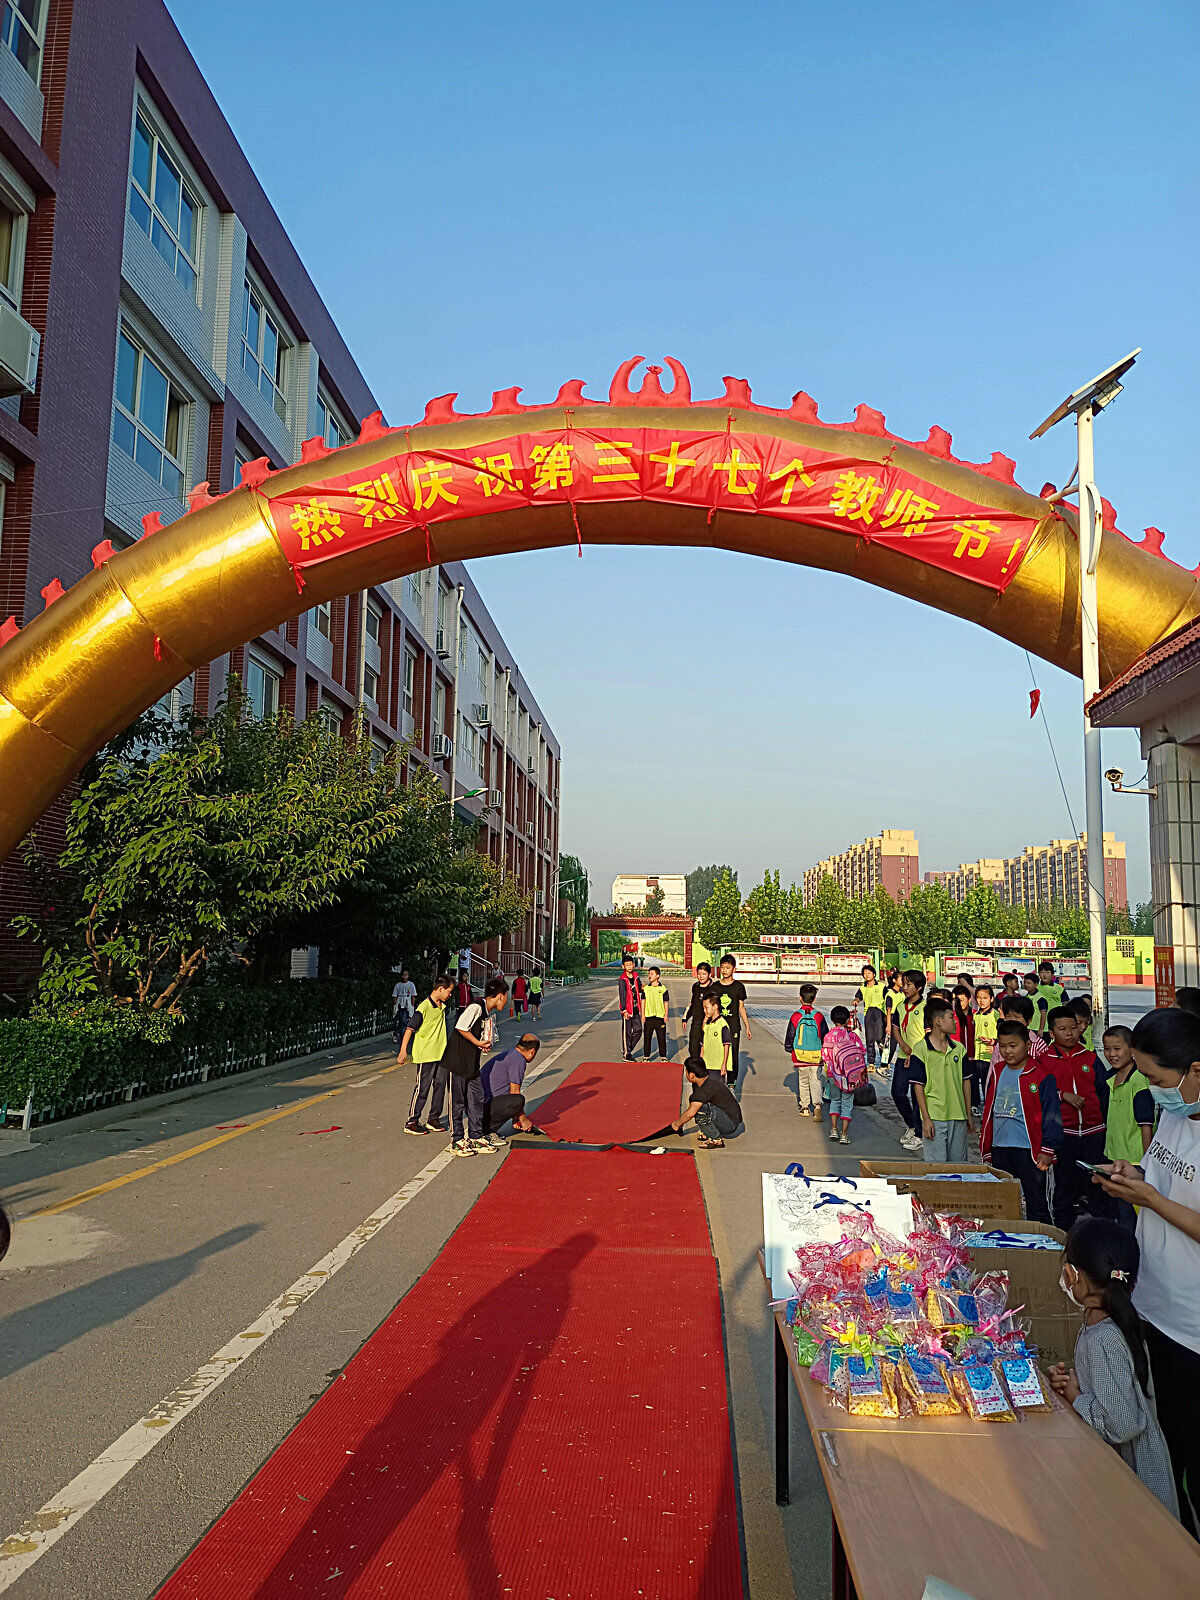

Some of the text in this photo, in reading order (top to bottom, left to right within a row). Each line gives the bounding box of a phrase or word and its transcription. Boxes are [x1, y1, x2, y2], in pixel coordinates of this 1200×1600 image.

[288, 440, 1022, 574] 热烈庆祝第三十七个教师节！
